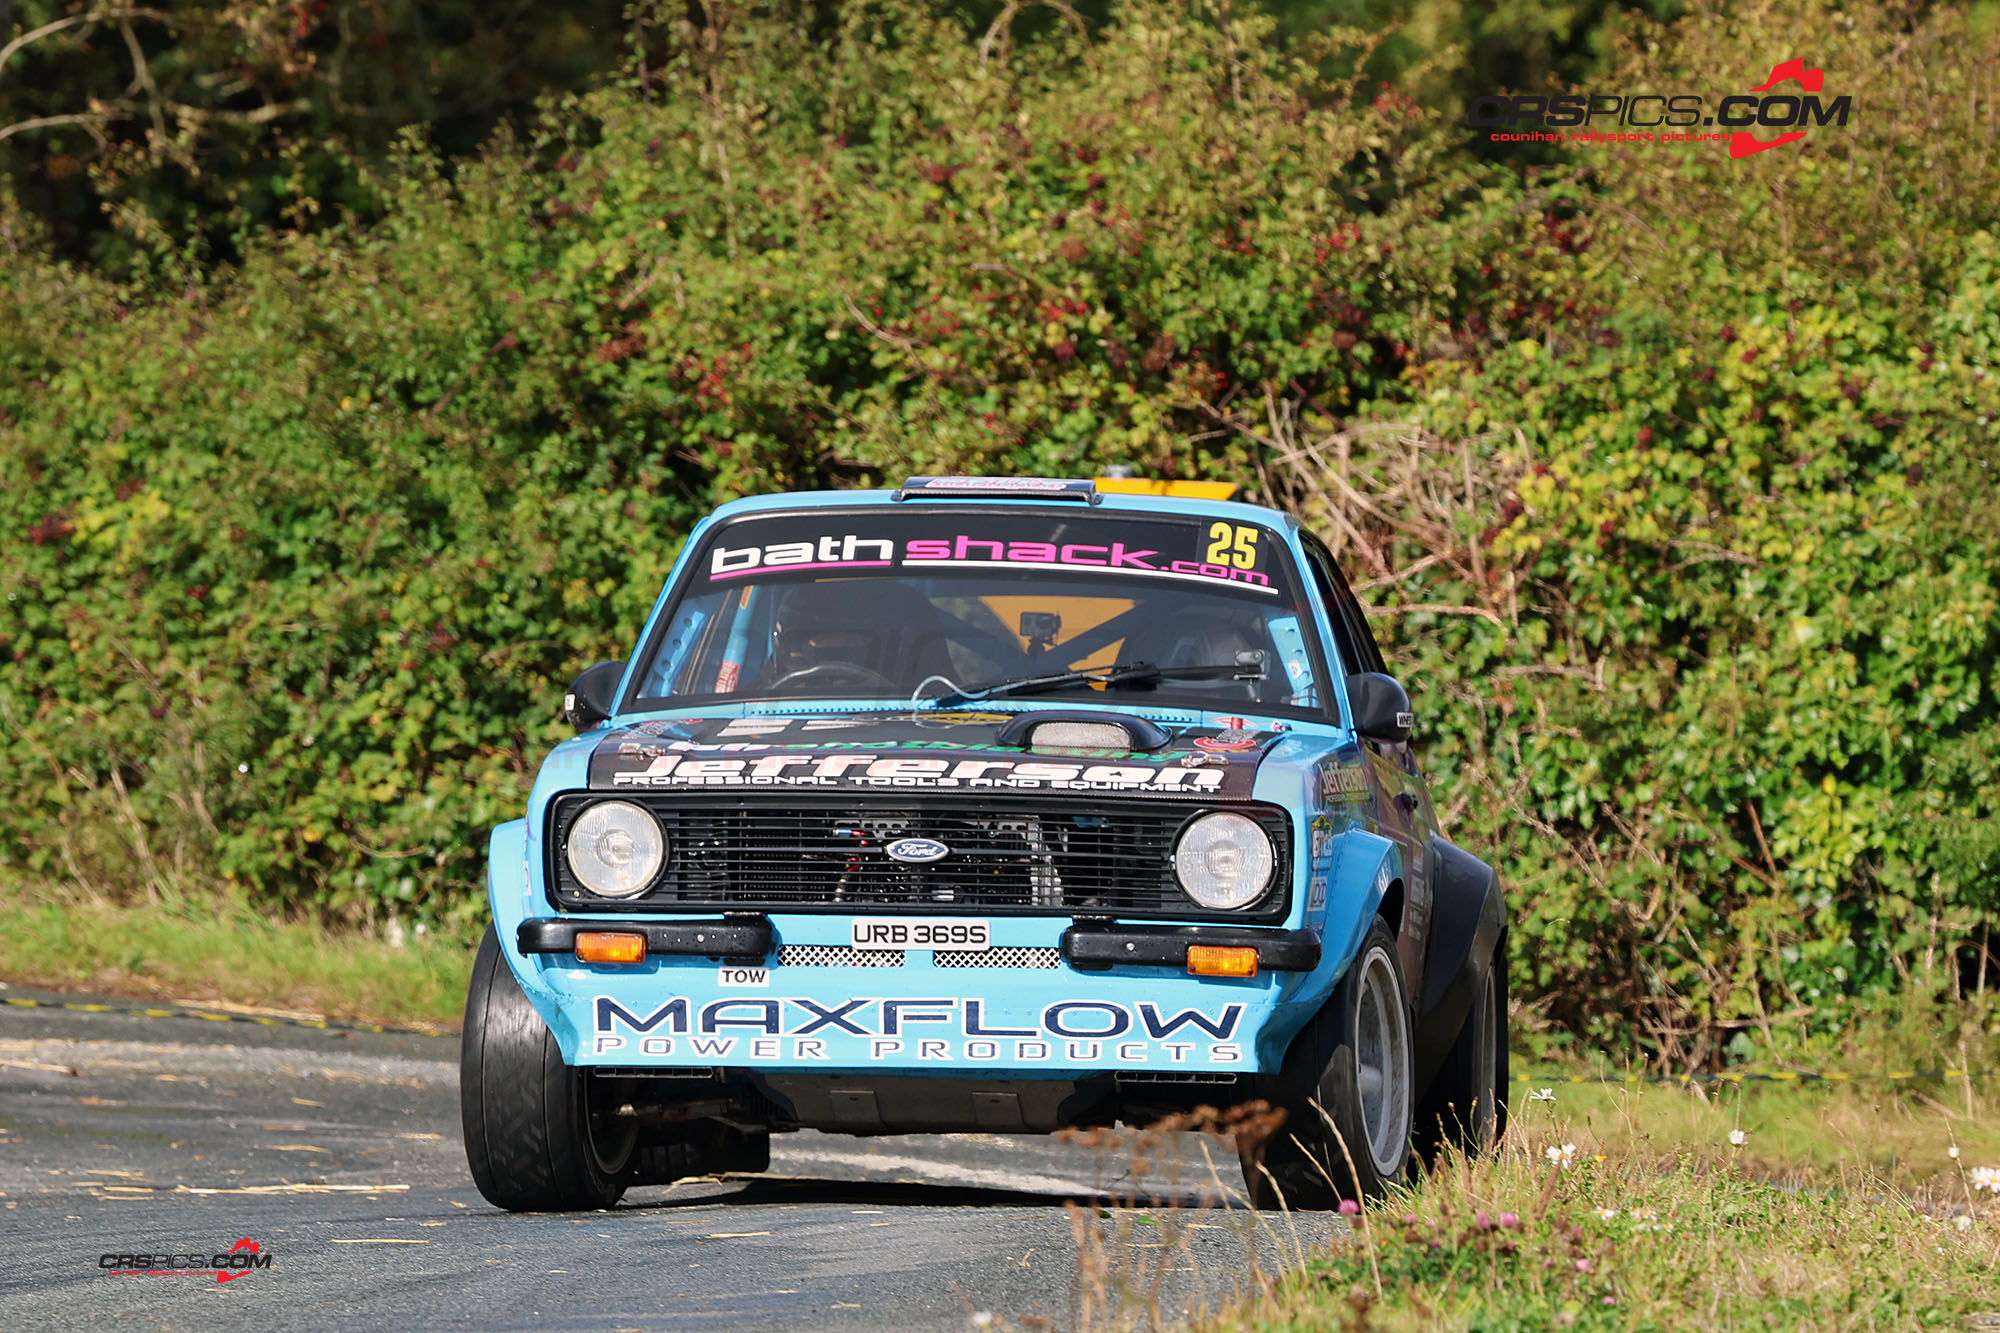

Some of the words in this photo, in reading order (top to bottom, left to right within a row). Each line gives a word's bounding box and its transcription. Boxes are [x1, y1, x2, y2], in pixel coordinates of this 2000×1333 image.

[1206, 521, 1258, 570] 25
[613, 776, 838, 786] PROFESSIONAL
[969, 779, 1041, 789] AND
[1052, 781, 1221, 794] EQUIPMENT
[897, 843, 938, 856] Ford
[721, 968, 767, 984] TOW
[593, 996, 1247, 1042] MAXFLOW
[594, 1035, 830, 1060] POWER
[870, 1038, 1245, 1064] PRODUCTS
